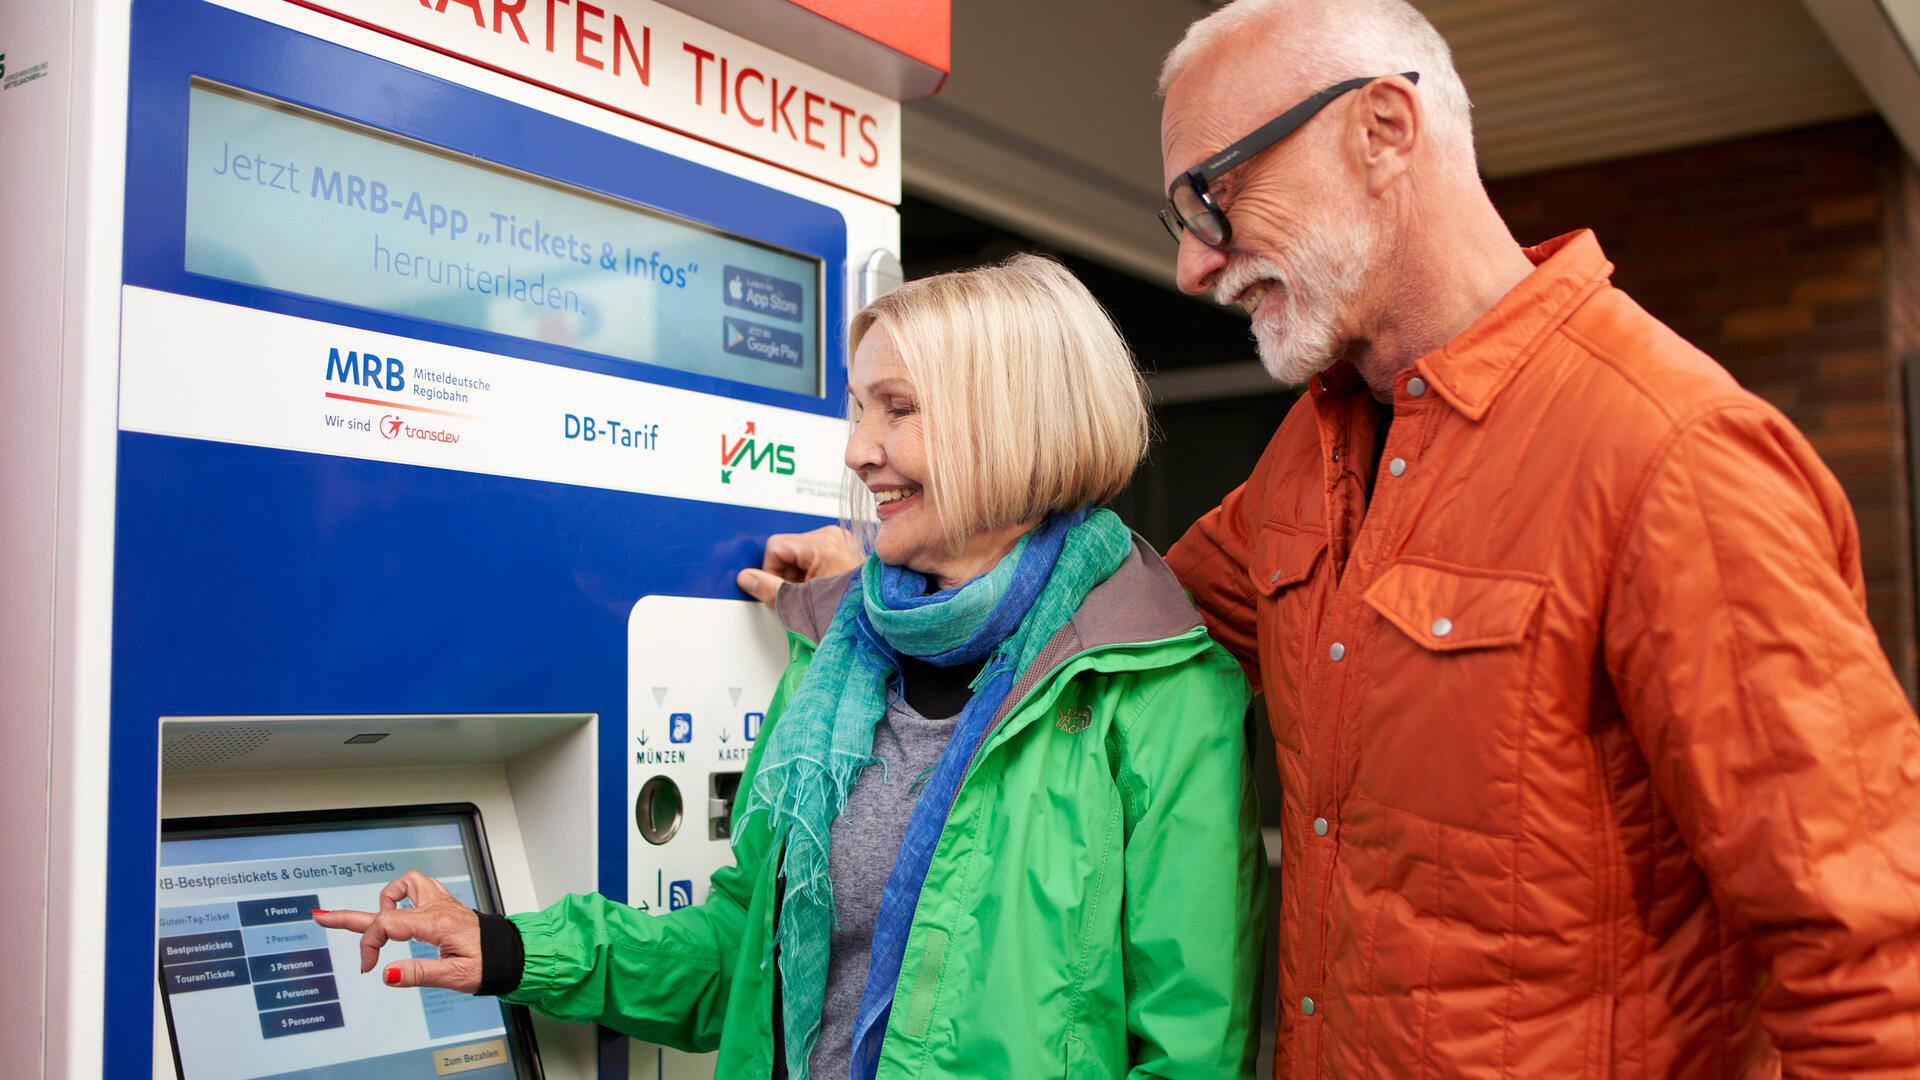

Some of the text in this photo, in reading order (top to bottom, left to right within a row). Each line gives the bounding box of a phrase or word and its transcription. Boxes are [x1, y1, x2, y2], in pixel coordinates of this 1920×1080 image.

[683, 42, 878, 168] TICKETS
[213, 142, 699, 288] Jetzt MRB-App „Tickets & Infos“
[374, 234, 586, 315] herunterladen.
[747, 288, 798, 314] App Store
[747, 336, 799, 363] Google Play
[326, 347, 405, 392] MRB
[413, 368, 491, 391] Mitteldeutsche
[413, 384, 468, 403] Regiobahn
[325, 414, 460, 444] Wir sind transdev
[565, 413, 659, 451] DB-Tarif
[721, 433, 796, 476] VMS
[637, 748, 685, 764] MÜNZEN
[281, 868, 290, 881] &
[293, 861, 395, 878] Guten-Tag-Tickets
[264, 906, 298, 917] 1 Person
[166, 940, 233, 956] Bestpreistickets
[265, 933, 308, 945] 2 Personen
[270, 960, 313, 972] 3 Personen
[175, 969, 236, 984] TourenTickets
[276, 987, 319, 1000] 4 Personen
[282, 1014, 325, 1028] 5 Personen
[443, 1049, 500, 1067] Zum Bezahlen
